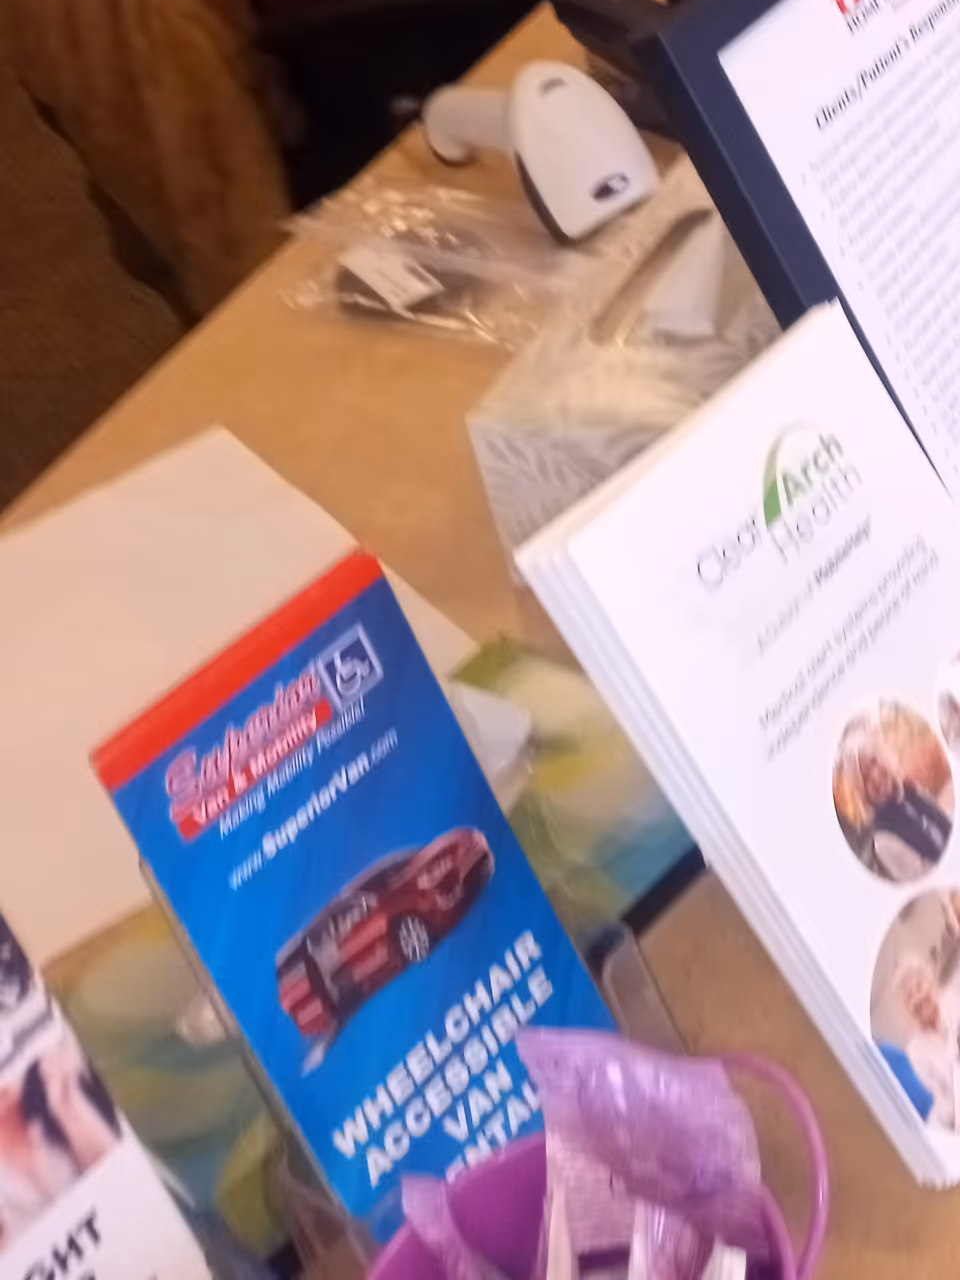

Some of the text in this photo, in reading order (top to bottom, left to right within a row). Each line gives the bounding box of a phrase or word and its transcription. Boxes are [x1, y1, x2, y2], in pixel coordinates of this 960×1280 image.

[813, 35, 911, 132] Clients/Patient's
[697, 431, 845, 589] Clear Arch
[769, 461, 864, 566] Health
[218, 784, 266, 840] Making
[265, 743, 315, 798] Mobility
[229, 726, 399, 890] www.SuperiorVan.com
[332, 929, 542, 1159] WHEELCHAIR
[366, 965, 553, 1190] ACCESSIBLE
[441, 1056, 514, 1144] VAN
[445, 1080, 543, 1185] ENTAL
